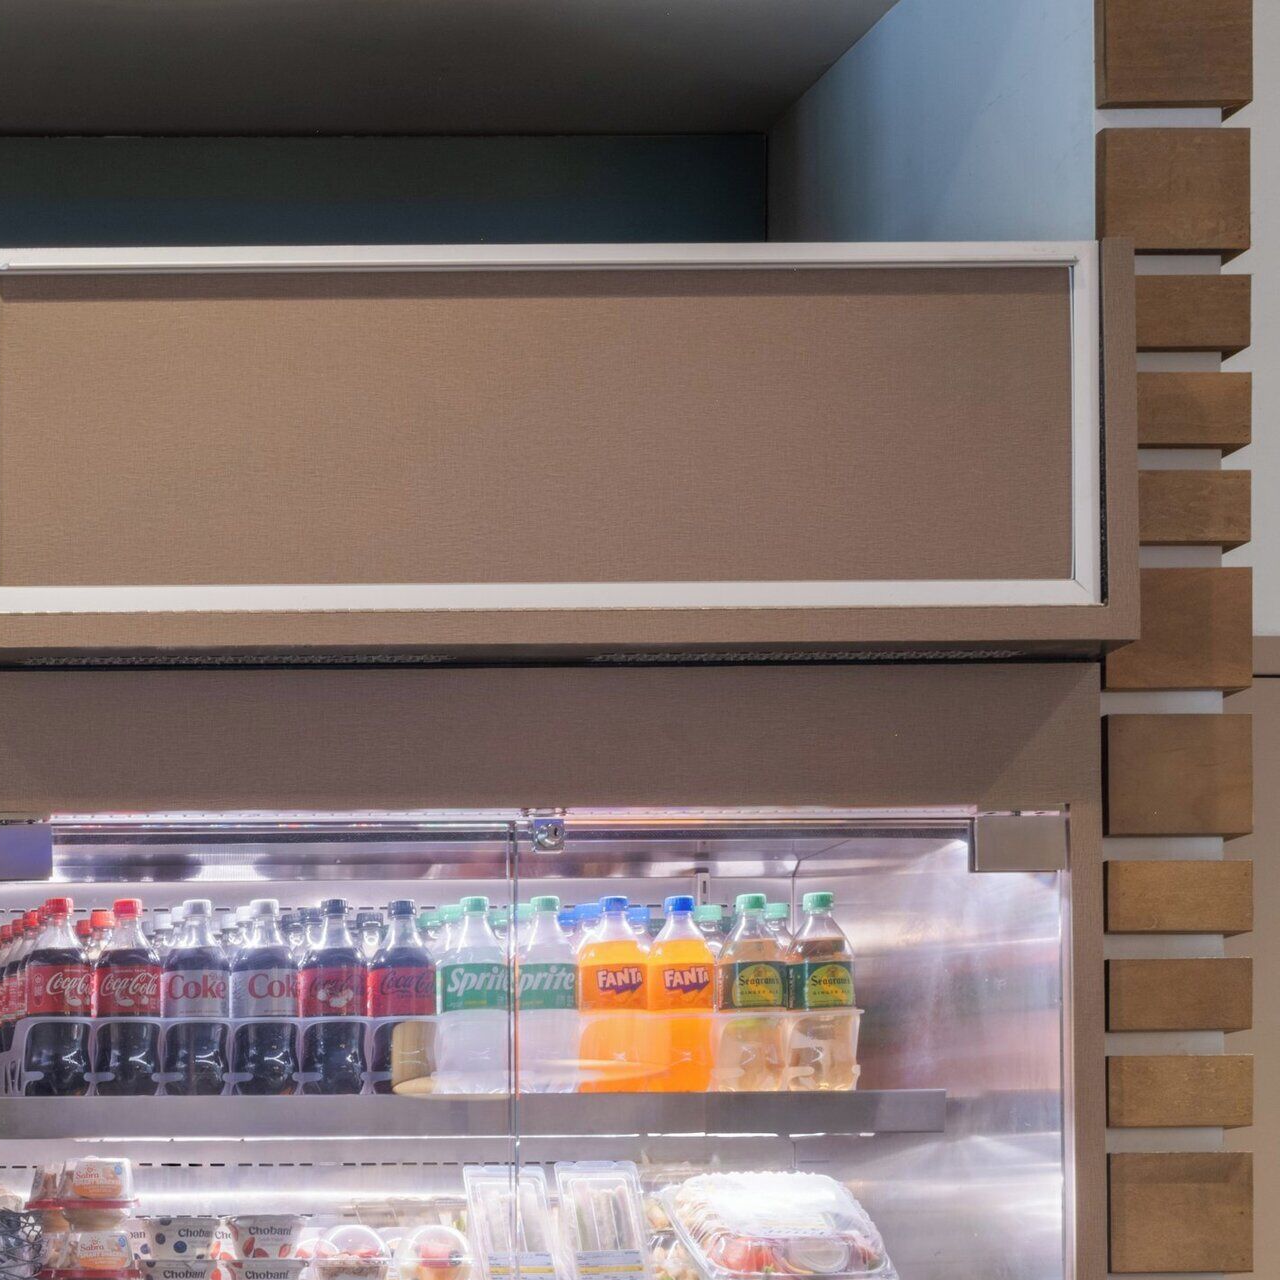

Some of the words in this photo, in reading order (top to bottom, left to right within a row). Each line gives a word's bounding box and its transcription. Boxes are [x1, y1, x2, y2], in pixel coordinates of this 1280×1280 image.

[168, 974, 227, 999] Coke
[248, 973, 297, 998] Cok
[519, 966, 575, 997] prite
[664, 966, 710, 989] FANTA
[248, 1226, 292, 1236] Chobani
[163, 1269, 207, 1280] Chobani
[245, 1270, 289, 1280] Chobani
